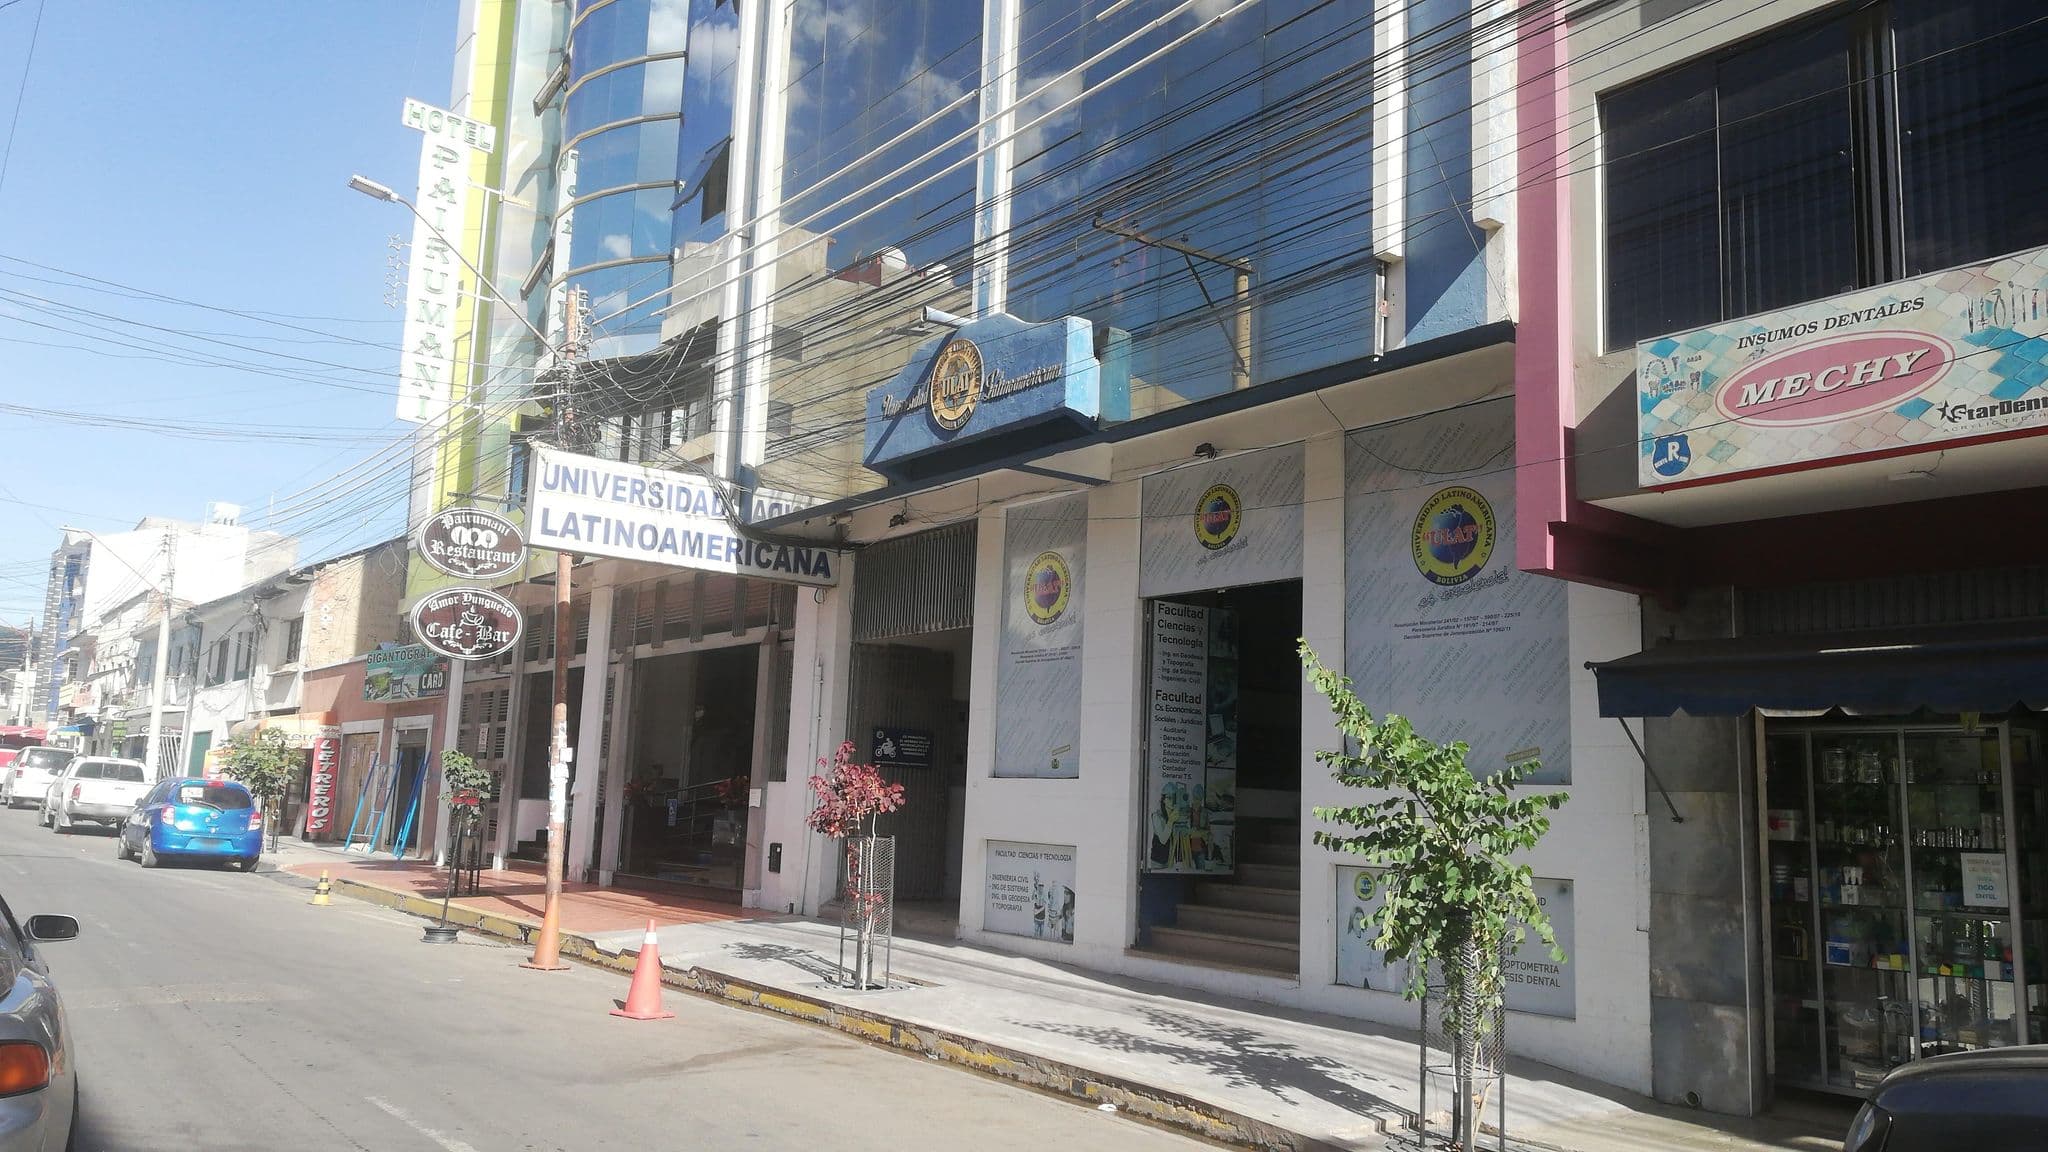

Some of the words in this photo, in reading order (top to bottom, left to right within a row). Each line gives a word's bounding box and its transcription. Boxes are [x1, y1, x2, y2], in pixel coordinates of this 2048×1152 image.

[408, 102, 491, 150] HOTEL
[410, 144, 460, 421] PAIRUMANI
[1736, 320, 1818, 350] INSUMOS
[1823, 296, 1925, 331] DENTALES
[1735, 347, 1931, 409] MECHY
[542, 463, 729, 518] UNIVERSIDAD
[440, 511, 511, 537] Pairumani
[1417, 497, 1440, 559] UNIVERSIDAD
[1440, 489, 1492, 548] LATINOAMERICANA
[429, 539, 518, 564] Restaurant
[539, 507, 832, 579] LATINOAMERICANA
[1436, 575, 1468, 585] BOLIVIA
[428, 594, 460, 613] Amor
[1158, 603, 1204, 619] Facultad
[476, 625, 510, 643] Bar
[1157, 619, 1196, 633] Ciencias
[1157, 634, 1204, 649] Tecnología
[1155, 689, 1202, 705] Facultad
[310, 739, 336, 829] LETREROS
[995, 849, 1016, 858] FACULTAD
[1018, 851, 1039, 860] CIENCIAS
[1504, 959, 1560, 975] OPTOMETRIA
[1526, 974, 1561, 988] DENTAL
